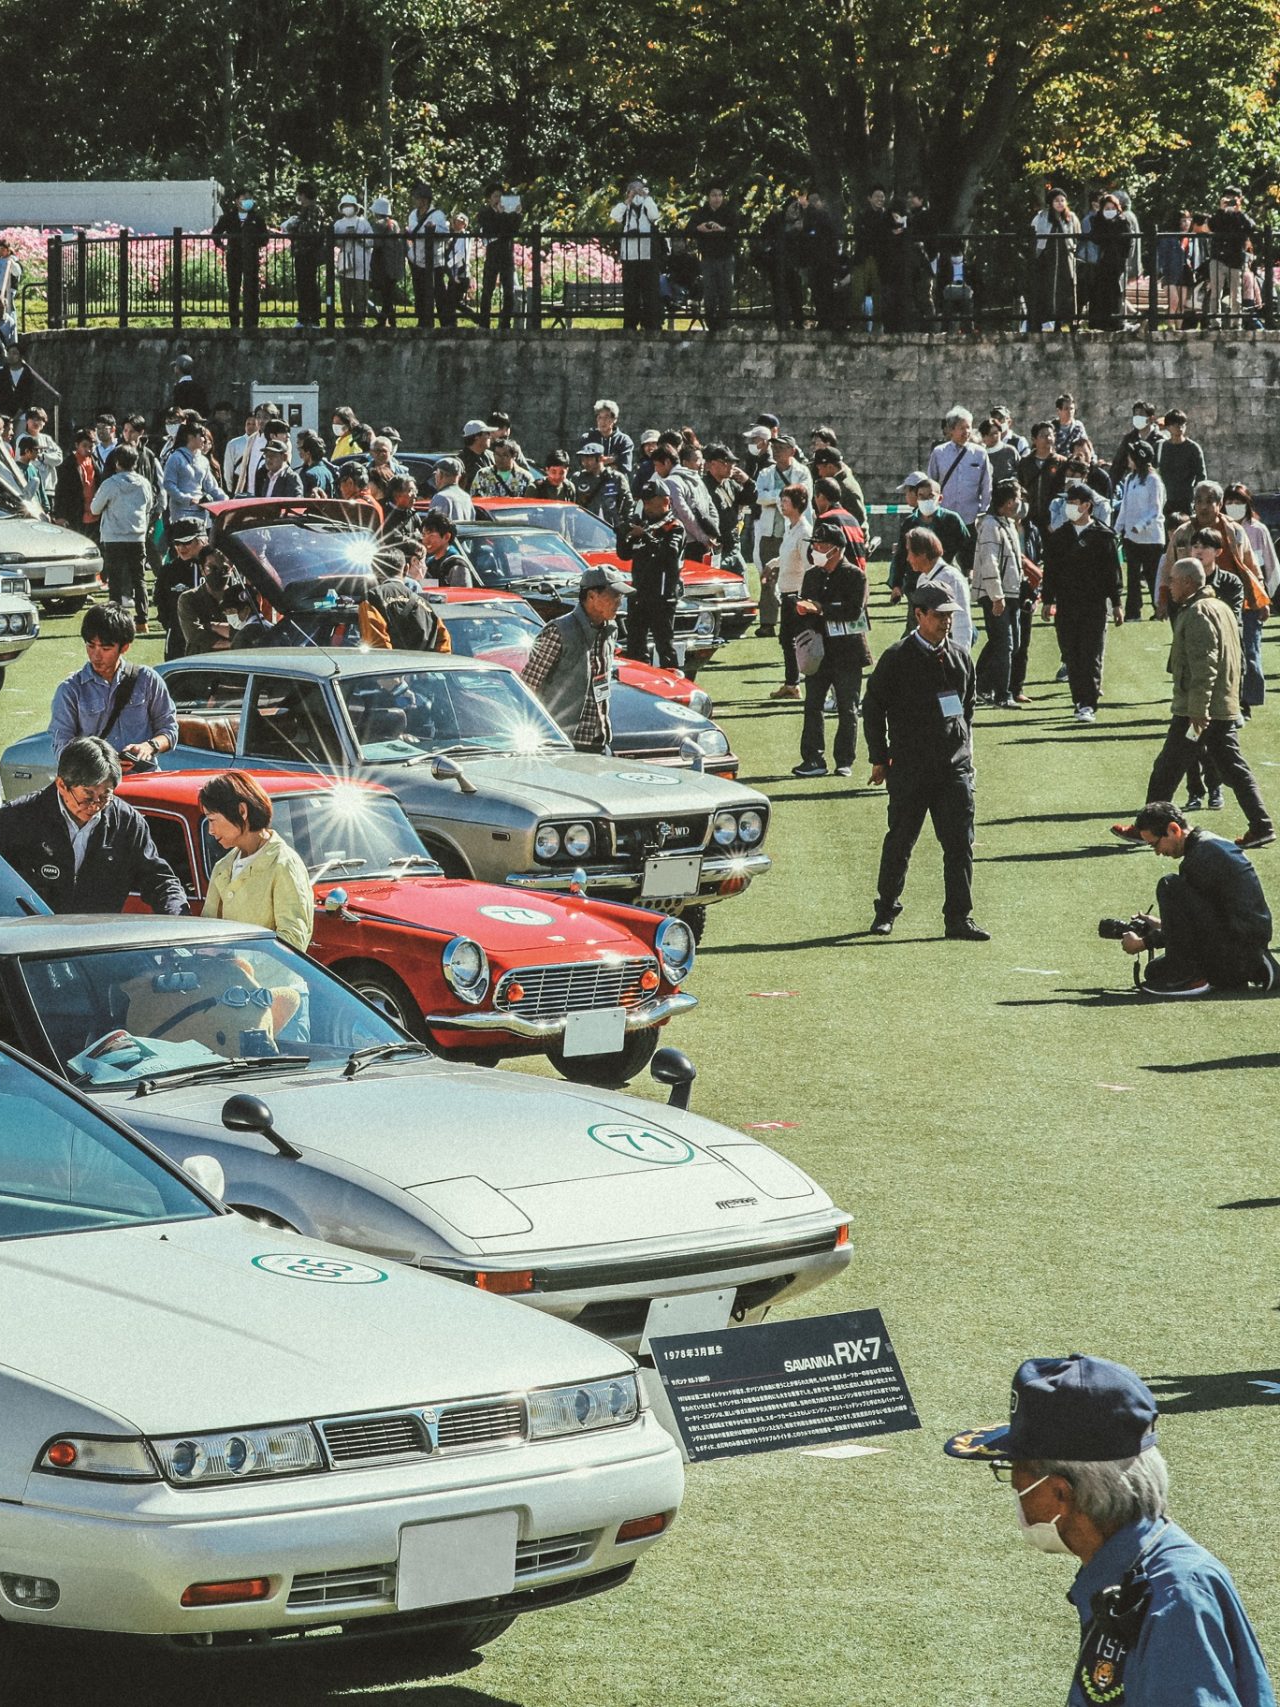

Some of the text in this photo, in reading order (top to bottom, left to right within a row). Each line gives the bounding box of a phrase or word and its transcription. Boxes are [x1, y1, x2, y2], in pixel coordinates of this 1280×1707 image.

[491, 909, 534, 921] 77
[607, 1131, 675, 1152] 71
[663, 1345, 724, 1361] 1978年3月誕生
[784, 1336, 882, 1373] SAVANNA RX-7
